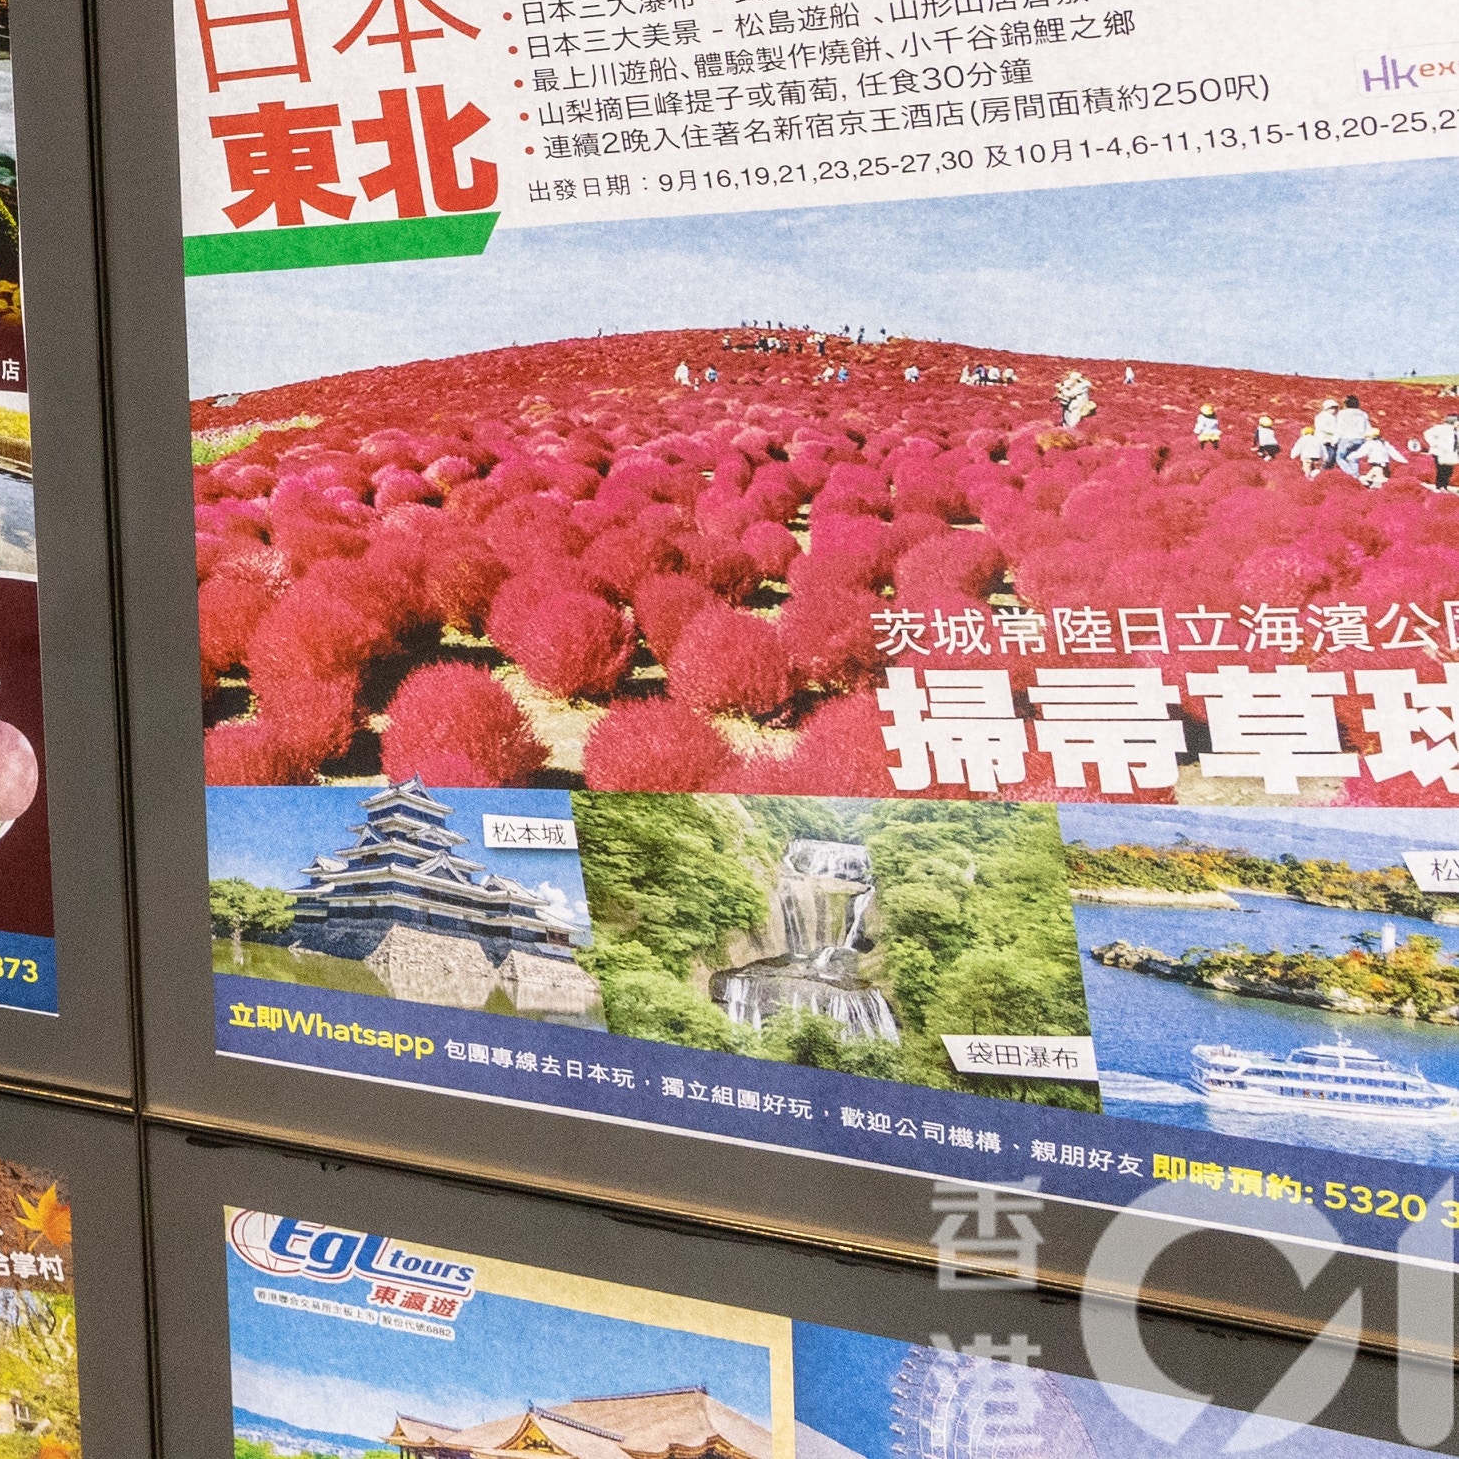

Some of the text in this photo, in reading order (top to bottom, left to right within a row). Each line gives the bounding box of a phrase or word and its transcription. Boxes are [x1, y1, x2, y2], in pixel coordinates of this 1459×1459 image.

[526, 19, 701, 60] 日本三大美景
[856, 56, 1033, 99] 任食30分鐘
[209, 83, 501, 228] 東北
[985, 109, 1459, 169] 及10月1-4,6-11,13,15-18,20-25,2
[492, 820, 568, 846] 松本城
[966, 1043, 1080, 1071] 袋田瀑布
[229, 1001, 435, 1060] 立即Whatsapp
[1324, 1181, 1427, 1223] 5320
[389, 1248, 475, 1283] tours
[370, 1283, 460, 1319] 東瀛遊
